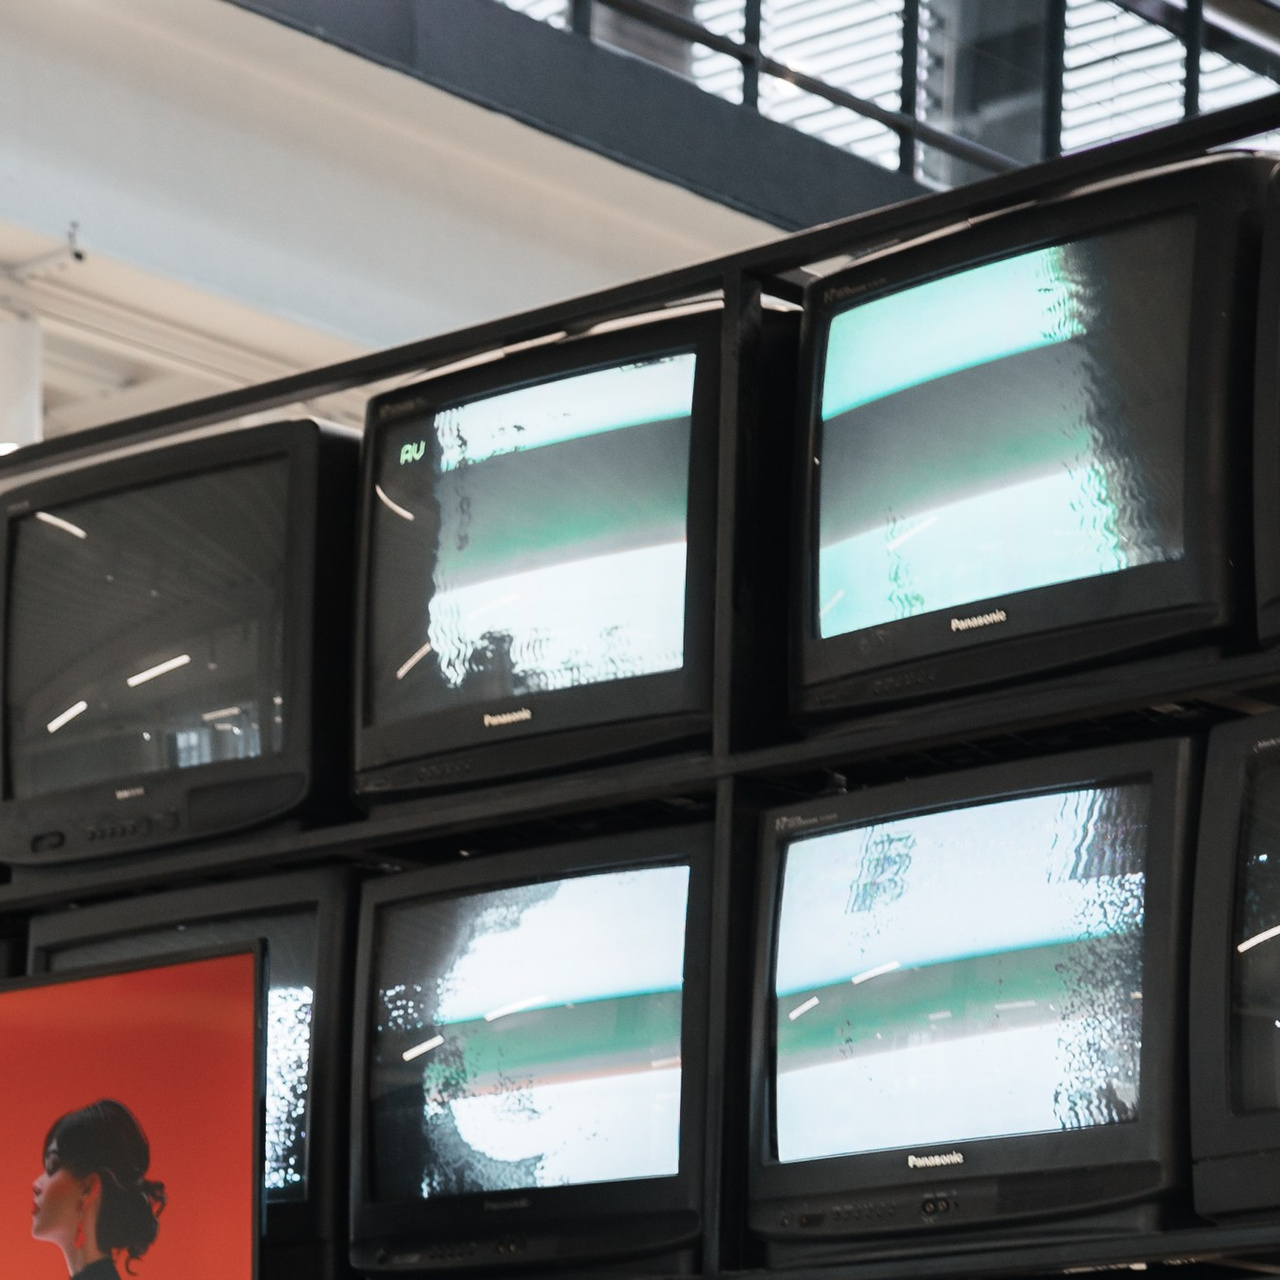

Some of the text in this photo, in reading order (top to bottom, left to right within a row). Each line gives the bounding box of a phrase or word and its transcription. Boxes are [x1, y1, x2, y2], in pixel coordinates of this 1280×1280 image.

[949, 608, 1008, 633] Panasonic
[482, 706, 533, 729] Panasonic
[907, 1150, 965, 1169] Panasonic
